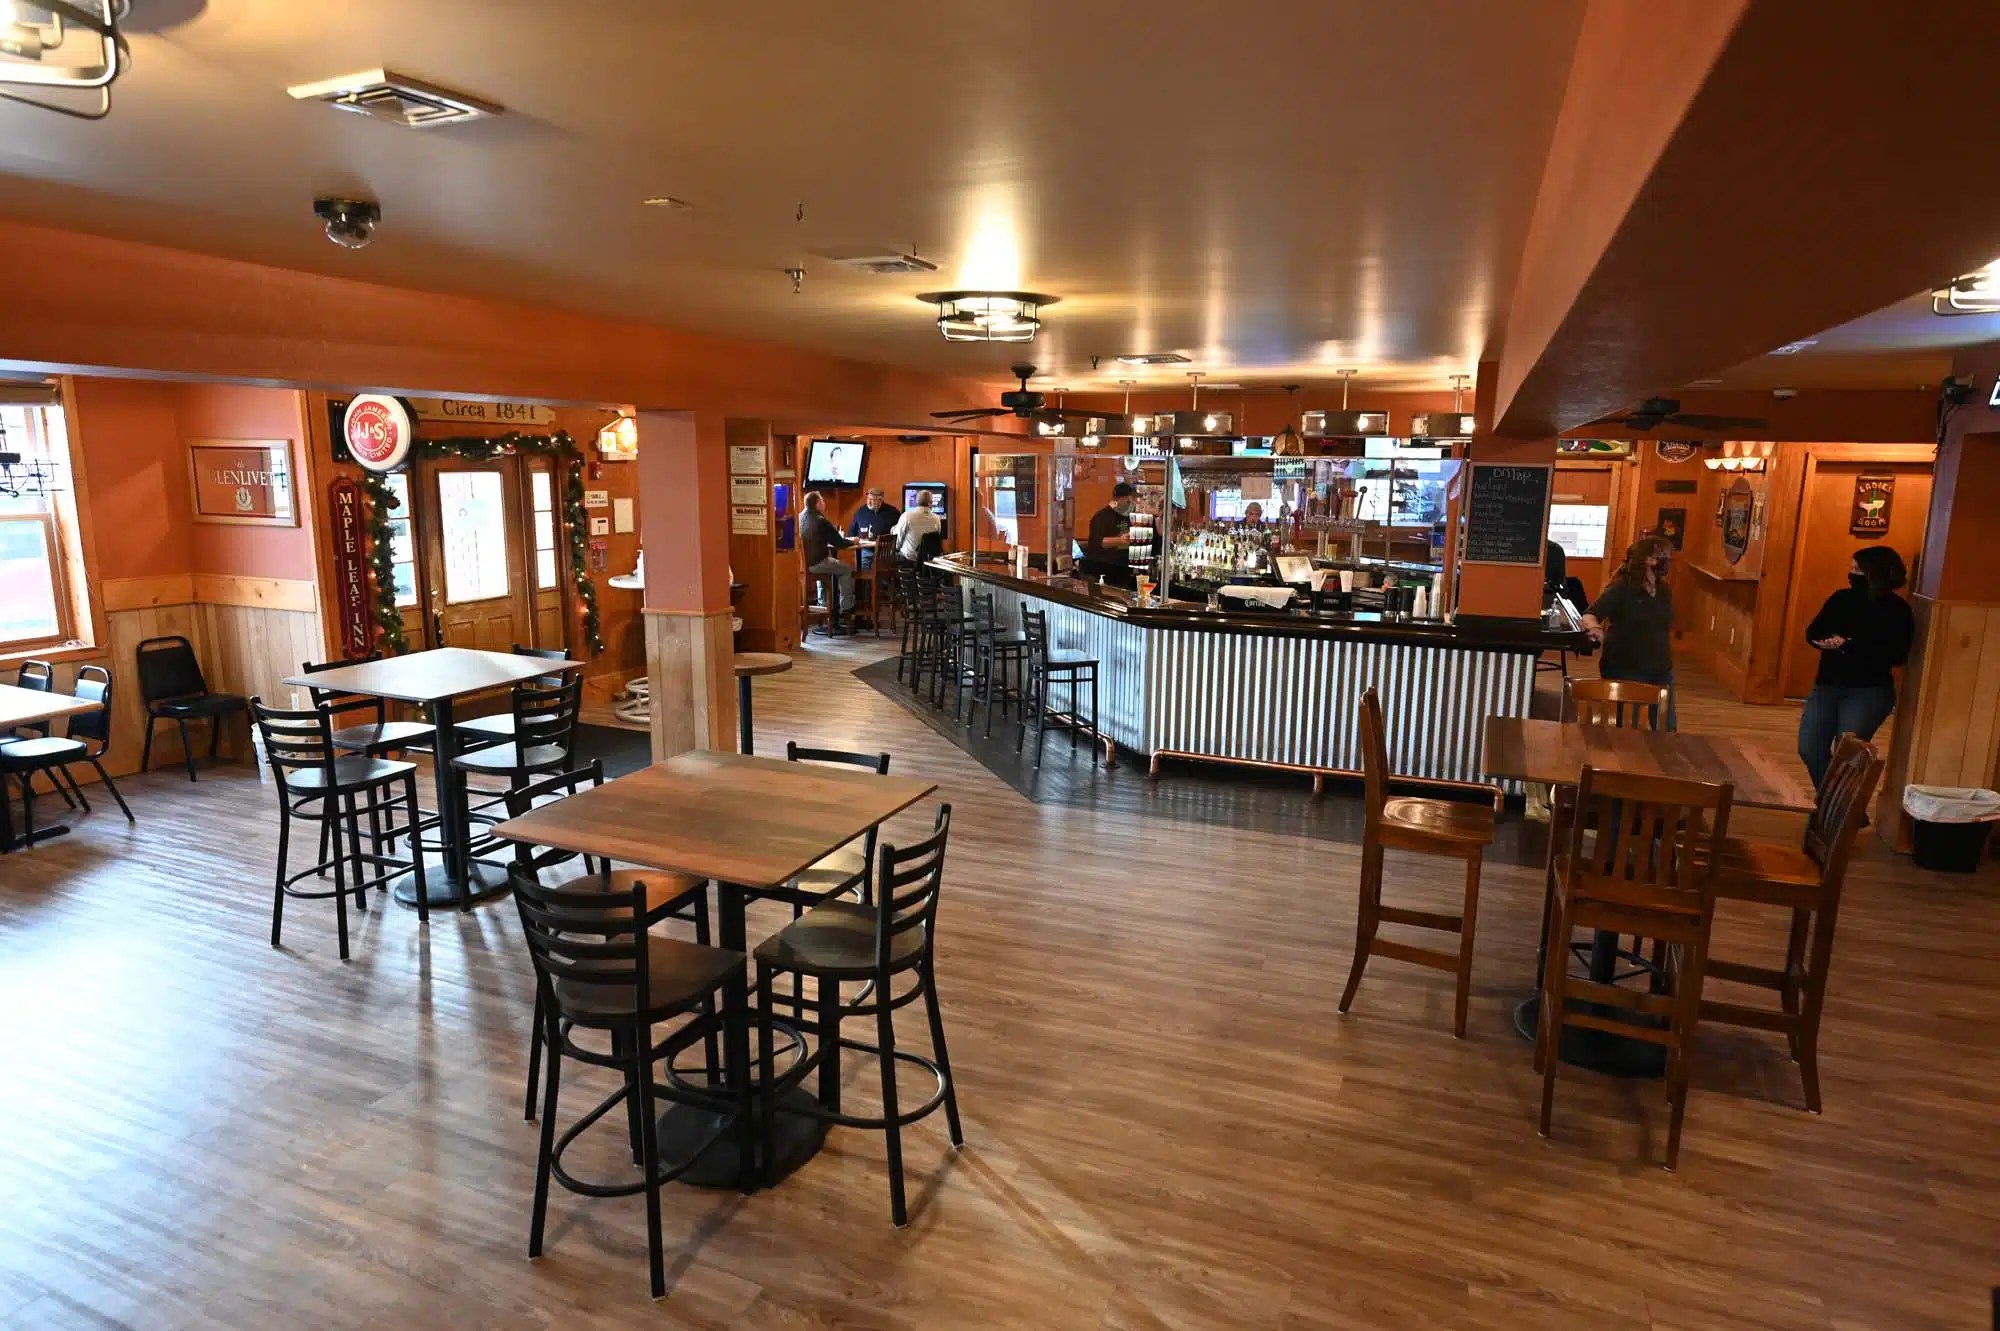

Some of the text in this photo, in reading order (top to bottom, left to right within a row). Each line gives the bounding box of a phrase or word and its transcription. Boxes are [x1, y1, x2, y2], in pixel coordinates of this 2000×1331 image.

[442, 399, 536, 419] Circa 1841
[210, 470, 276, 487] LENLIVET
[339, 492, 356, 553] MAPLE
[347, 559, 361, 607] LEAF
[352, 612, 365, 648] INN
